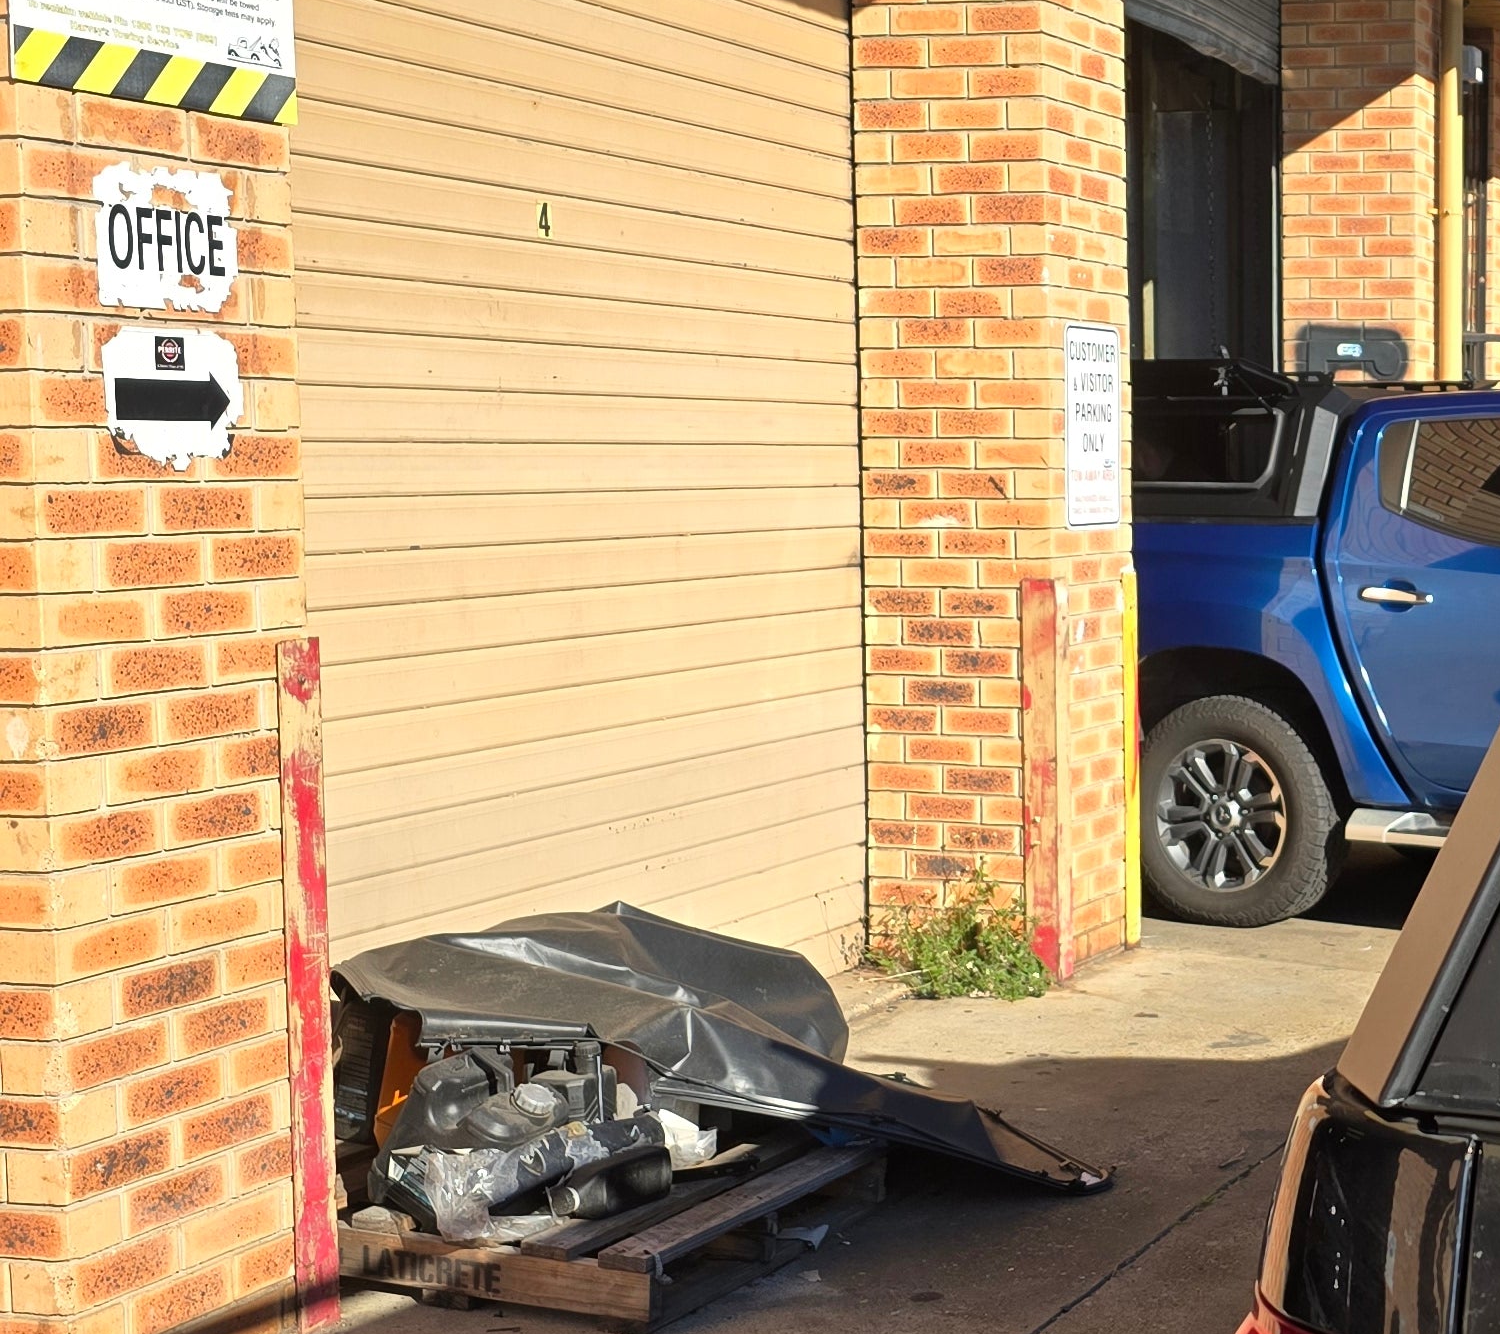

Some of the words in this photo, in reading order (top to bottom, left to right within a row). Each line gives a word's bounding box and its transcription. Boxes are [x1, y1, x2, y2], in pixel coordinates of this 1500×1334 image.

[239, 1, 260, 12] towed
[538, 202, 551, 238] 4
[108, 203, 226, 277] OFFICE
[1069, 340, 1116, 364] CUSTOMER
[1080, 372, 1114, 393] VISITOR
[1075, 402, 1112, 423] PARKING
[1082, 432, 1105, 453] ONLY
[362, 1244, 501, 1295] LATICRETE
